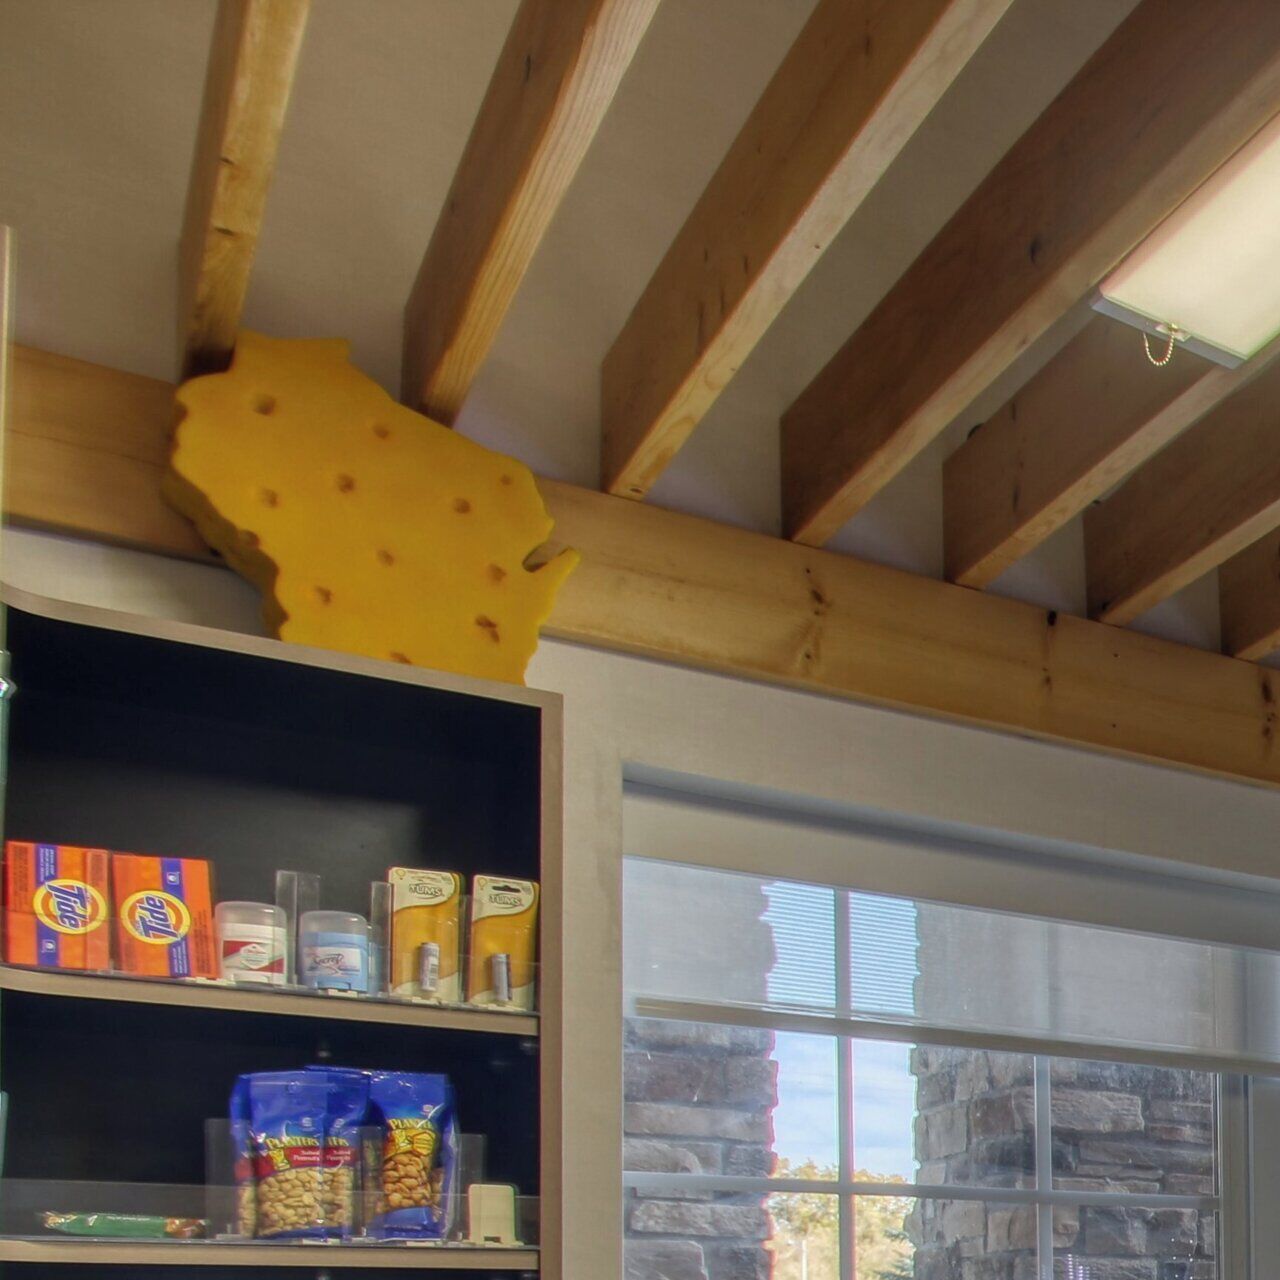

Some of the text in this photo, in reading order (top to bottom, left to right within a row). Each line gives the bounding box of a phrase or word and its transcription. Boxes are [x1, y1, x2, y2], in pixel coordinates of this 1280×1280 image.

[409, 883, 445, 897] TUMS
[489, 894, 524, 907] TUMS
[45, 881, 89, 930] Tide
[137, 894, 182, 941] Tide
